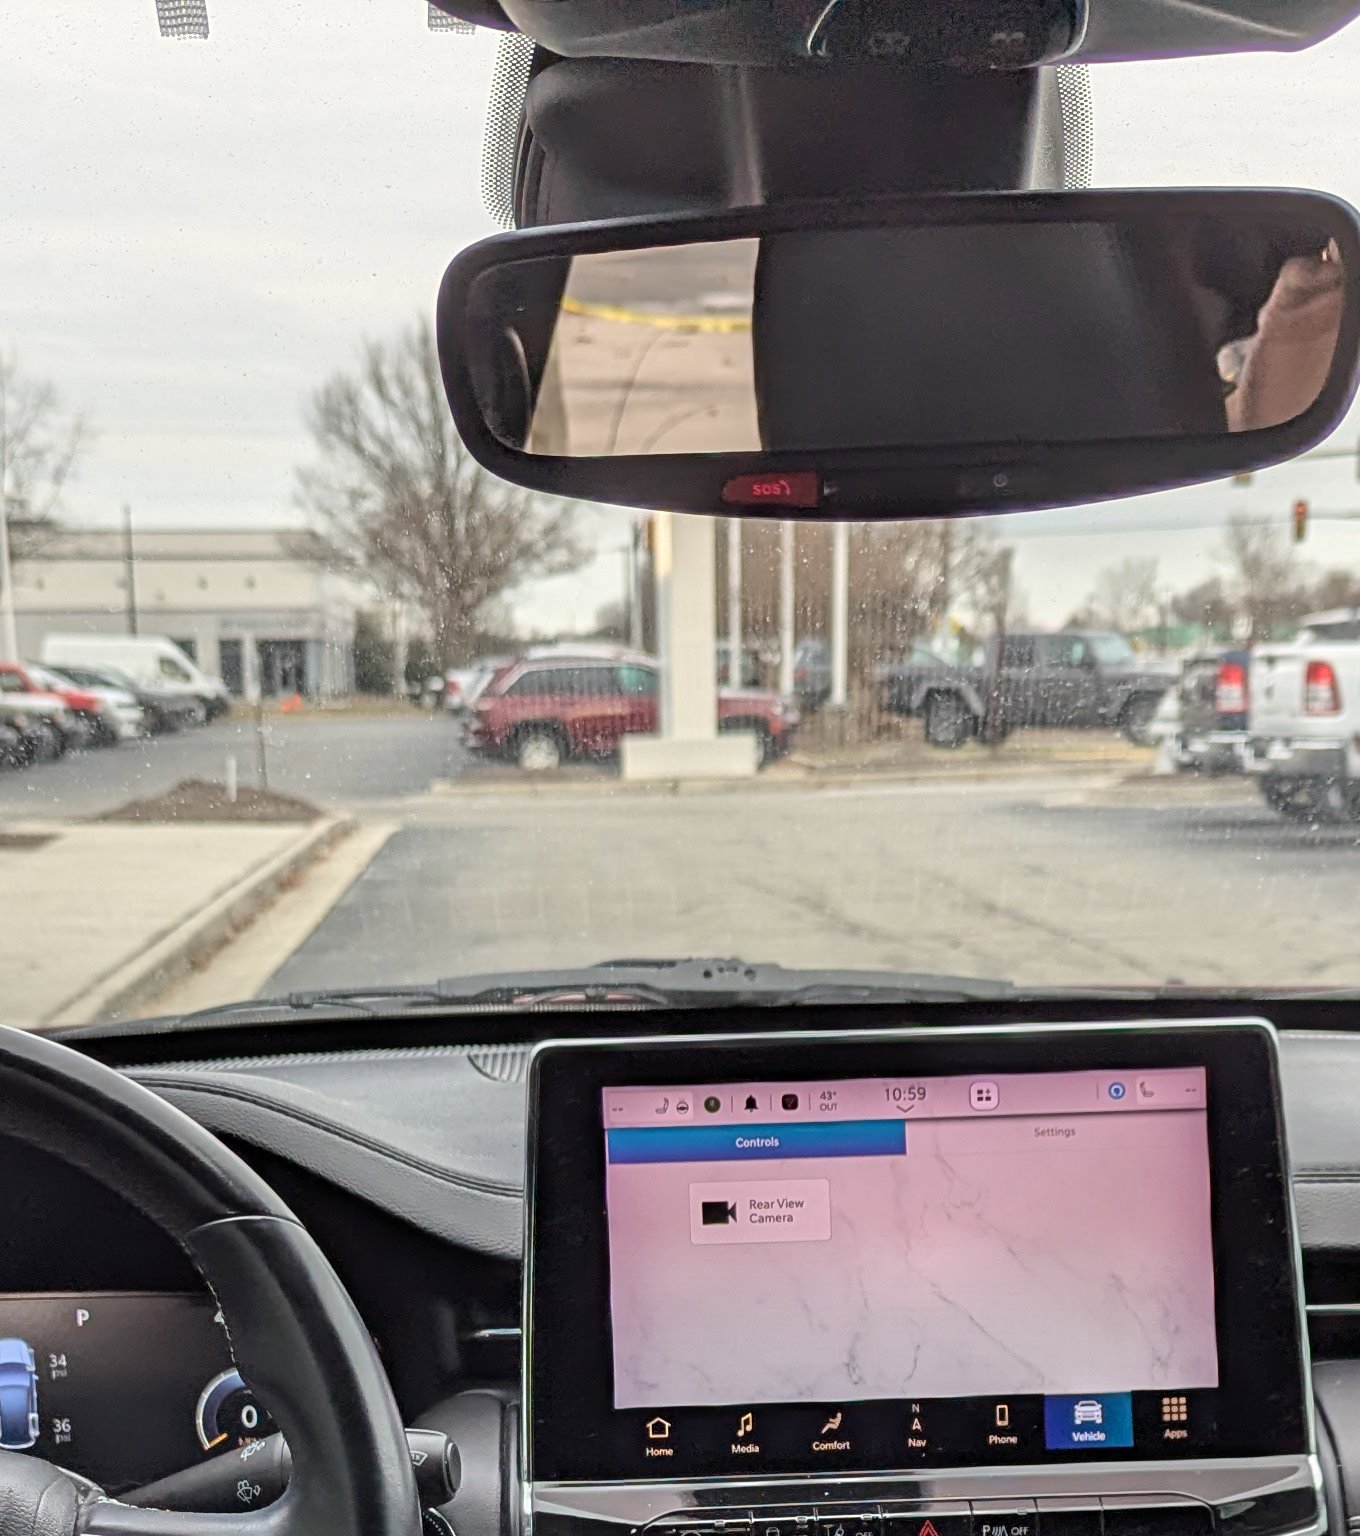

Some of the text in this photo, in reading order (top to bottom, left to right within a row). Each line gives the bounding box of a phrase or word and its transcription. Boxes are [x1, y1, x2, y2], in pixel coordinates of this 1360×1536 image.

[752, 484, 780, 495] SOS
[884, 1087, 926, 1102] 10:59
[820, 1102, 838, 1112] OUT
[1033, 1127, 1076, 1138] Settings
[735, 1136, 779, 1149] Controls
[749, 1199, 805, 1210] Rear View
[749, 1213, 794, 1224] Camera
[76, 1309, 90, 1327] P
[49, 1354, 67, 1368] 34
[241, 1405, 258, 1429] 0
[52, 1418, 71, 1433] 36
[989, 1434, 1018, 1445] Phone
[1072, 1431, 1106, 1442] Vehicle
[1163, 1428, 1188, 1440] Apps
[812, 1440, 851, 1451] Comfort
[908, 1438, 927, 1447] Nav
[646, 1447, 673, 1456] Home
[731, 1444, 760, 1453] Media
[1010, 1526, 1029, 1536] OFF
